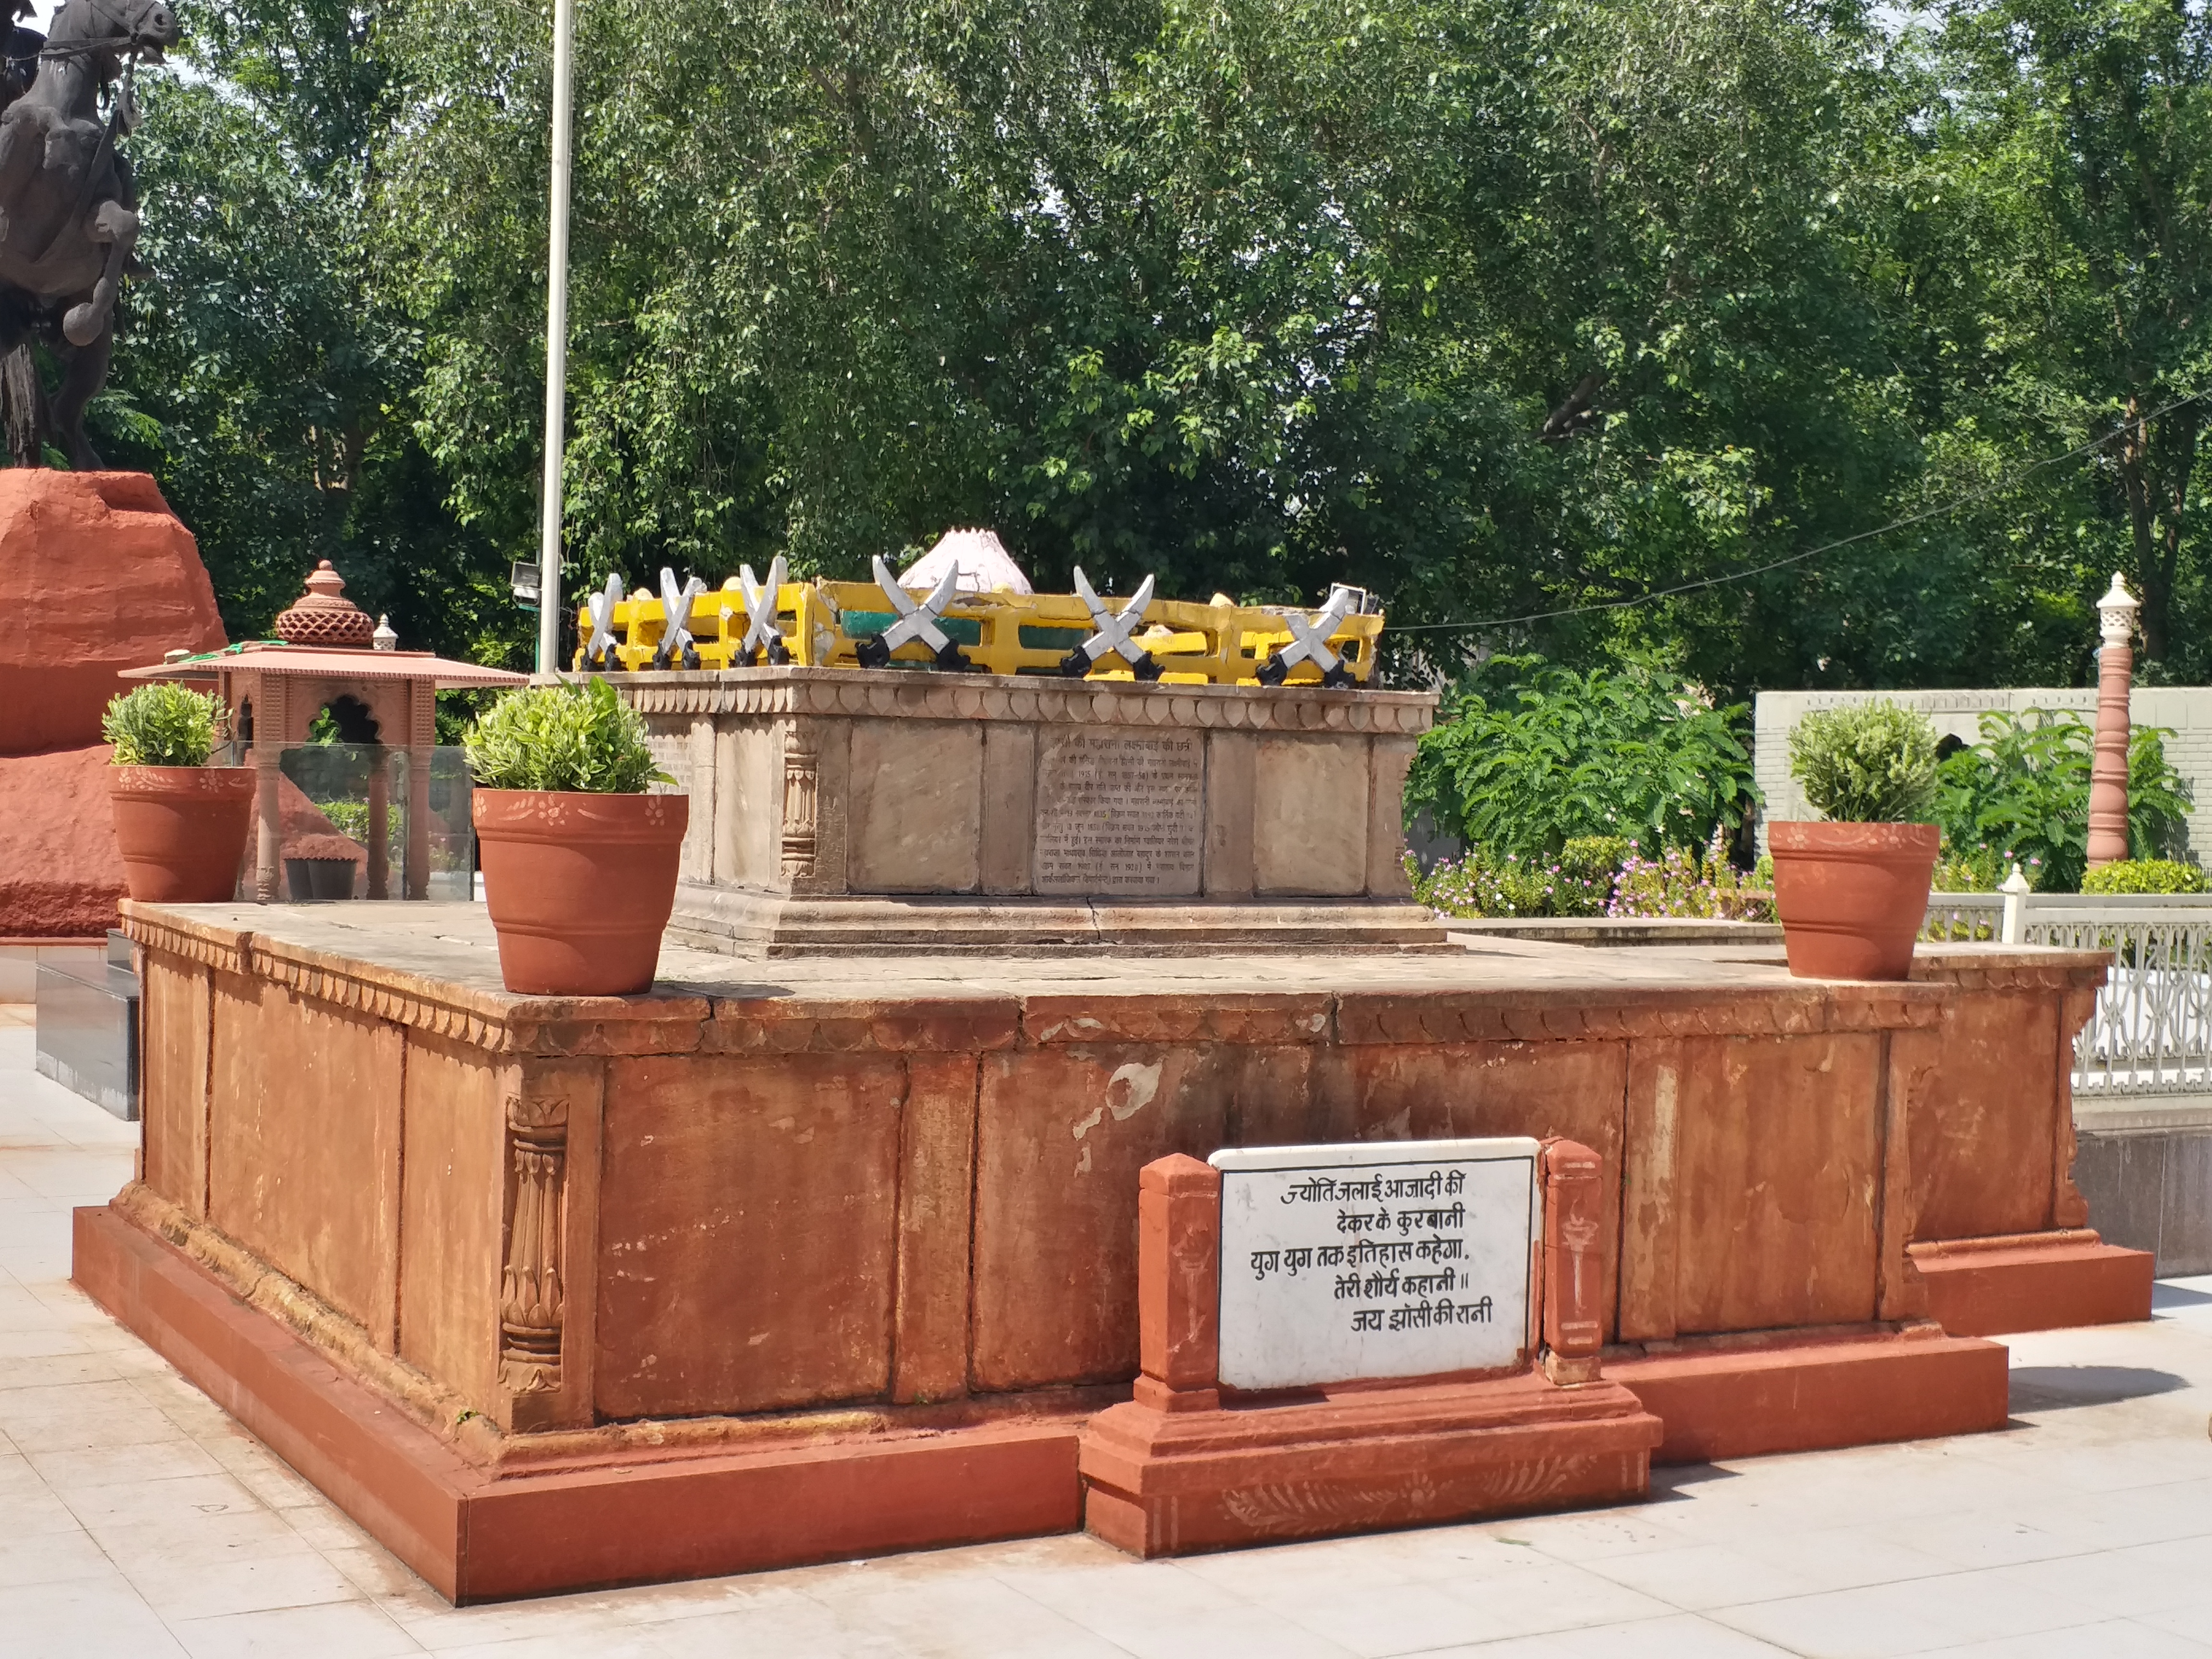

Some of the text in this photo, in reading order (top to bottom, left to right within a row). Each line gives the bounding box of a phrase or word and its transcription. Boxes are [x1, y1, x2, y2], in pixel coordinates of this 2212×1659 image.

[1280, 1177, 1337, 1204] ज्योति
[1334, 1173, 1384, 1202] जलाई
[1444, 1170, 1467, 1197] की
[1396, 1201, 1466, 1236] कुरबानी
[1251, 1250, 1280, 1281] युग
[1284, 1247, 1313, 1276] युग
[1317, 1245, 1344, 1267] तक
[1347, 1238, 1414, 1269] इतिहास
[1334, 1273, 1360, 1299] तेरी
[1363, 1267, 1399, 1299] शौर्य
[1401, 1266, 1455, 1298] कहानी
[1350, 1310, 1385, 1332] जय
[1433, 1298, 1455, 1326] की
[1456, 1295, 1493, 1324] रानी
